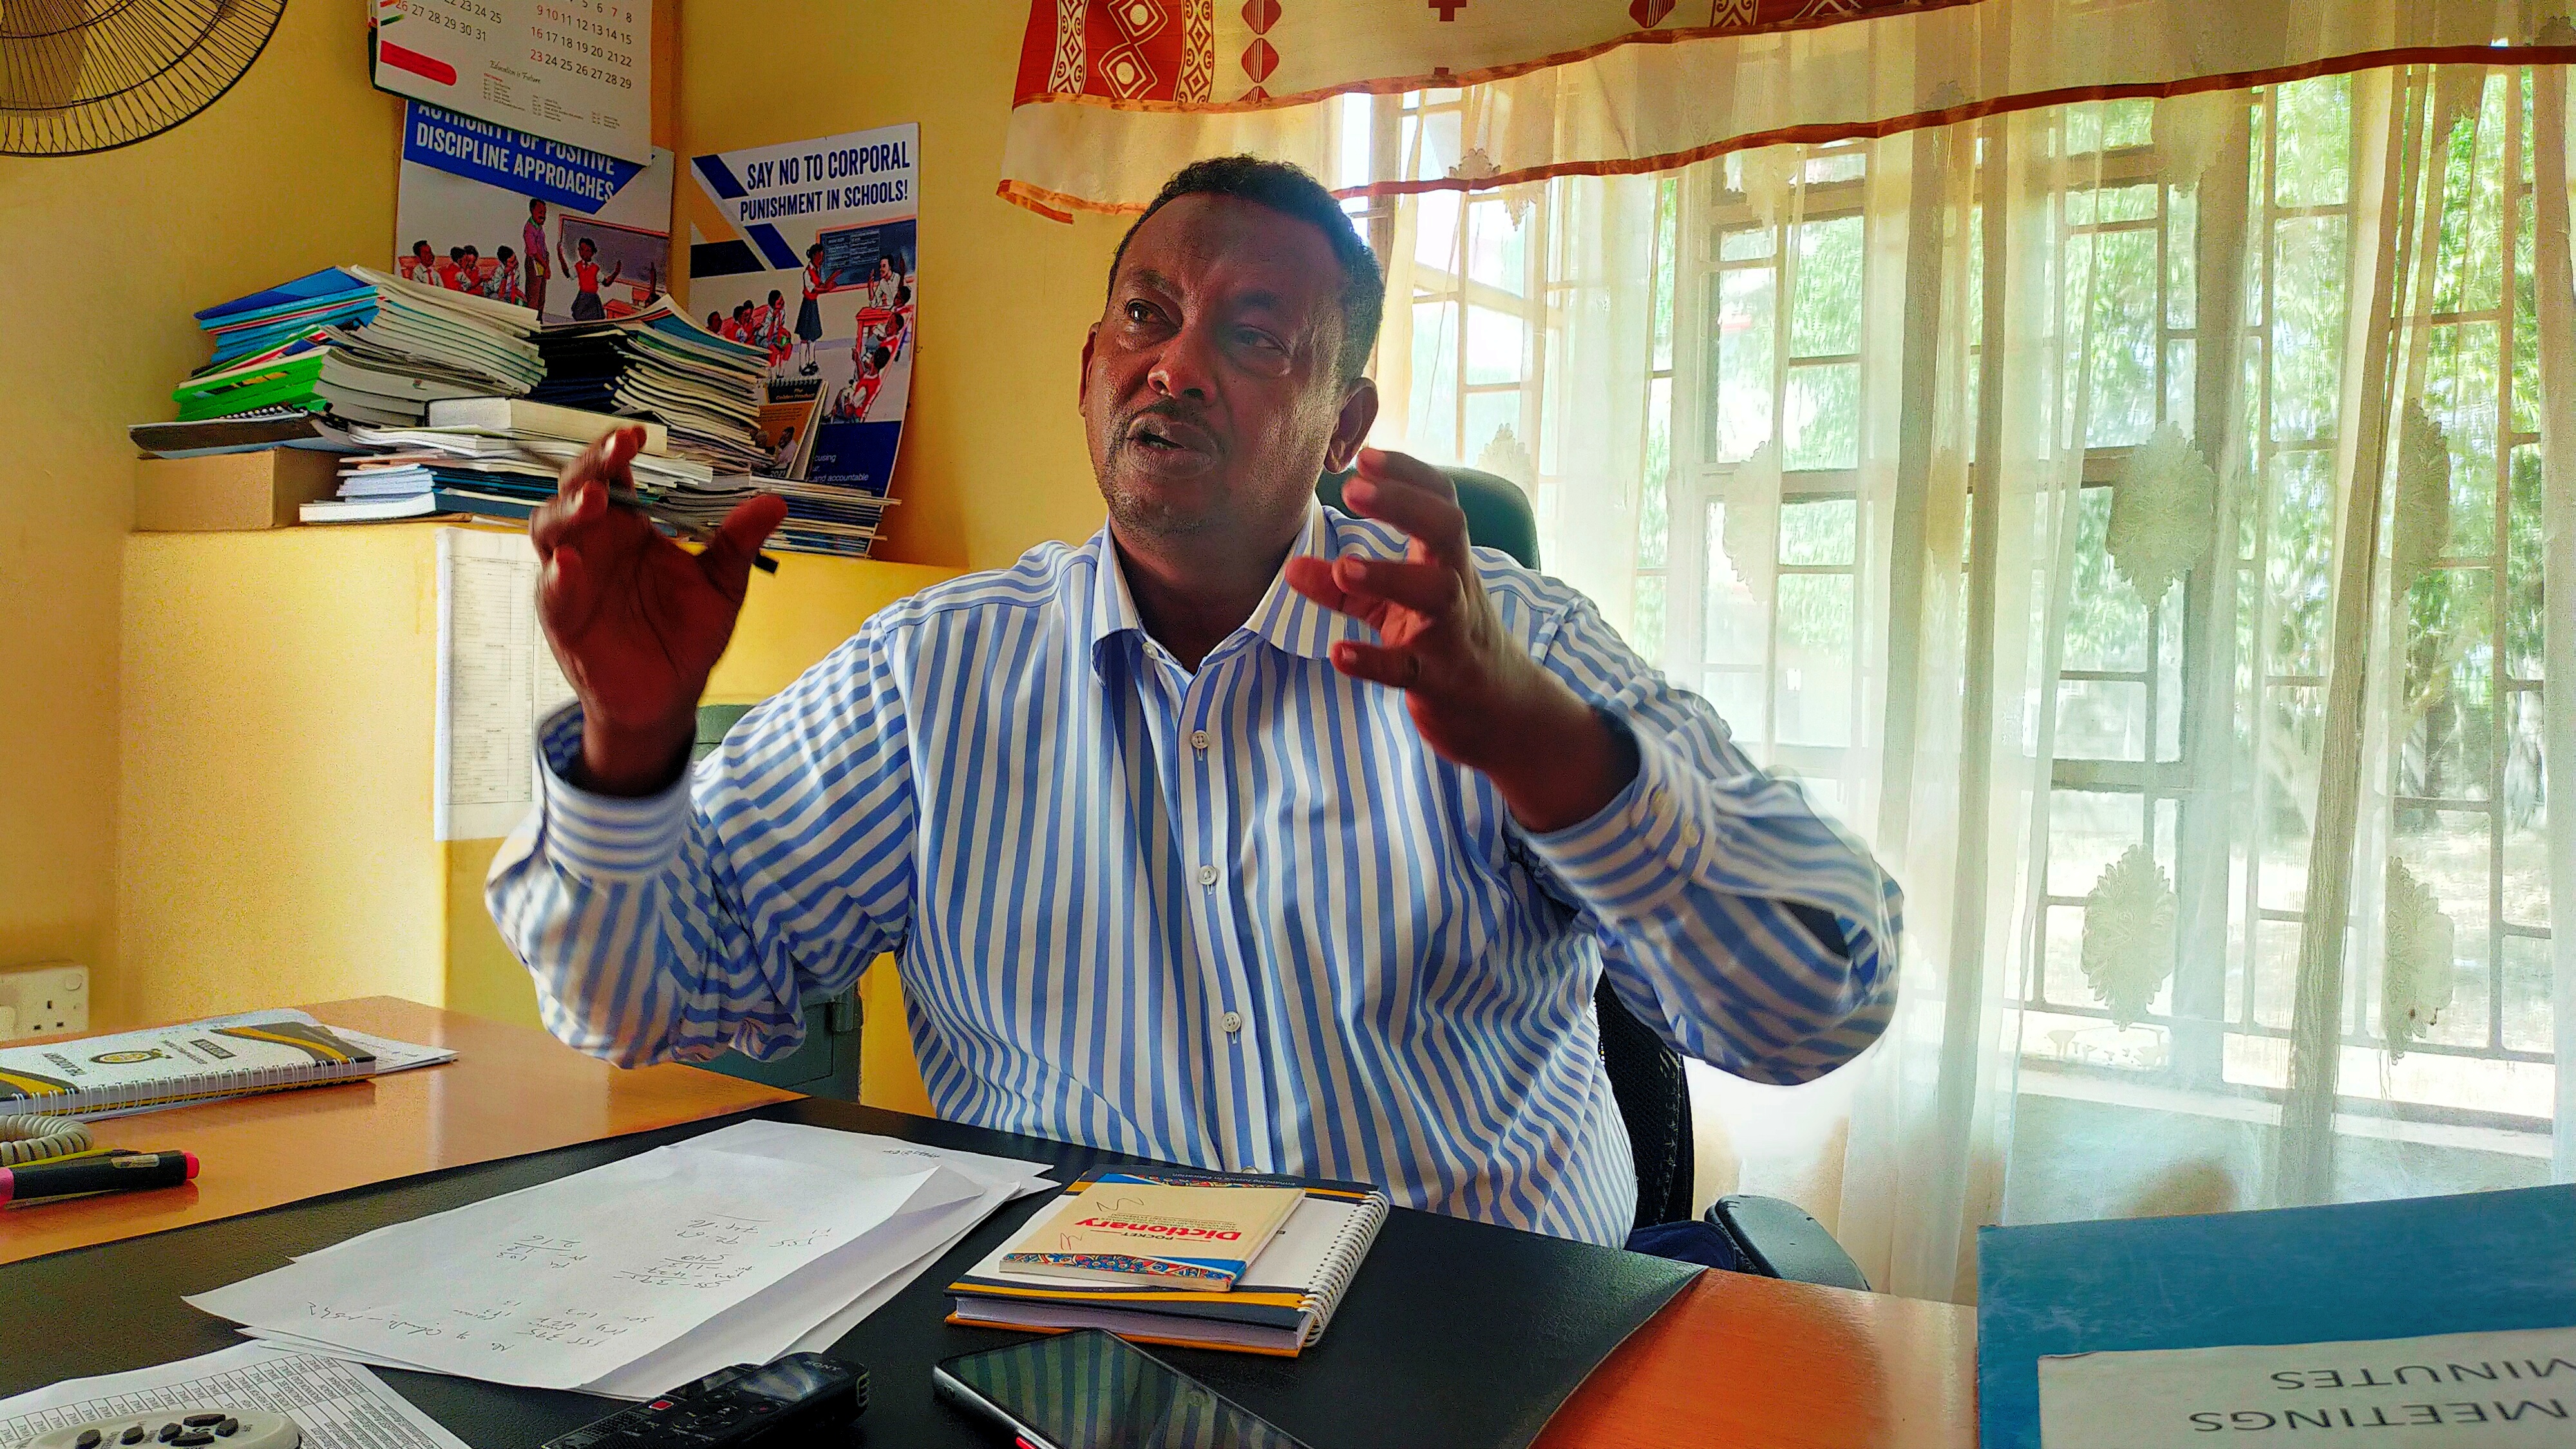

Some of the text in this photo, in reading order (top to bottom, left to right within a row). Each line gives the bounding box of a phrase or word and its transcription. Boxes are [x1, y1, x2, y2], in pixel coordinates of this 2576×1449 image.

[395, 0, 486, 41] 26 27 28 29 30 31
[460, 0, 471, 12] 23
[475, 5, 486, 17] 24
[490, 11, 502, 24] 25
[536, 6, 632, 44] 9 10 11 12 13 14 15
[597, 3, 603, 13] 6
[612, 6, 618, 17] 7
[626, 12, 632, 23] 8
[531, 26, 632, 67] 16 17 18 19 20 21 22
[530, 49, 632, 89] 23 24 25 26 27 28 29
[417, 122, 614, 201] DISCIPLINE APPROACHES
[747, 140, 911, 191] SAY NO TO CORPORAL
[740, 179, 908, 222] PUNISHMENT IN SCHOOLS!
[828, 473, 869, 482] accountable
[1074, 1217, 1242, 1240] Dictionary
[804, 1360, 841, 1371] SONY
[2269, 1358, 2576, 1390] MINUTES
[2188, 1398, 2568, 1432] MEETINGS
